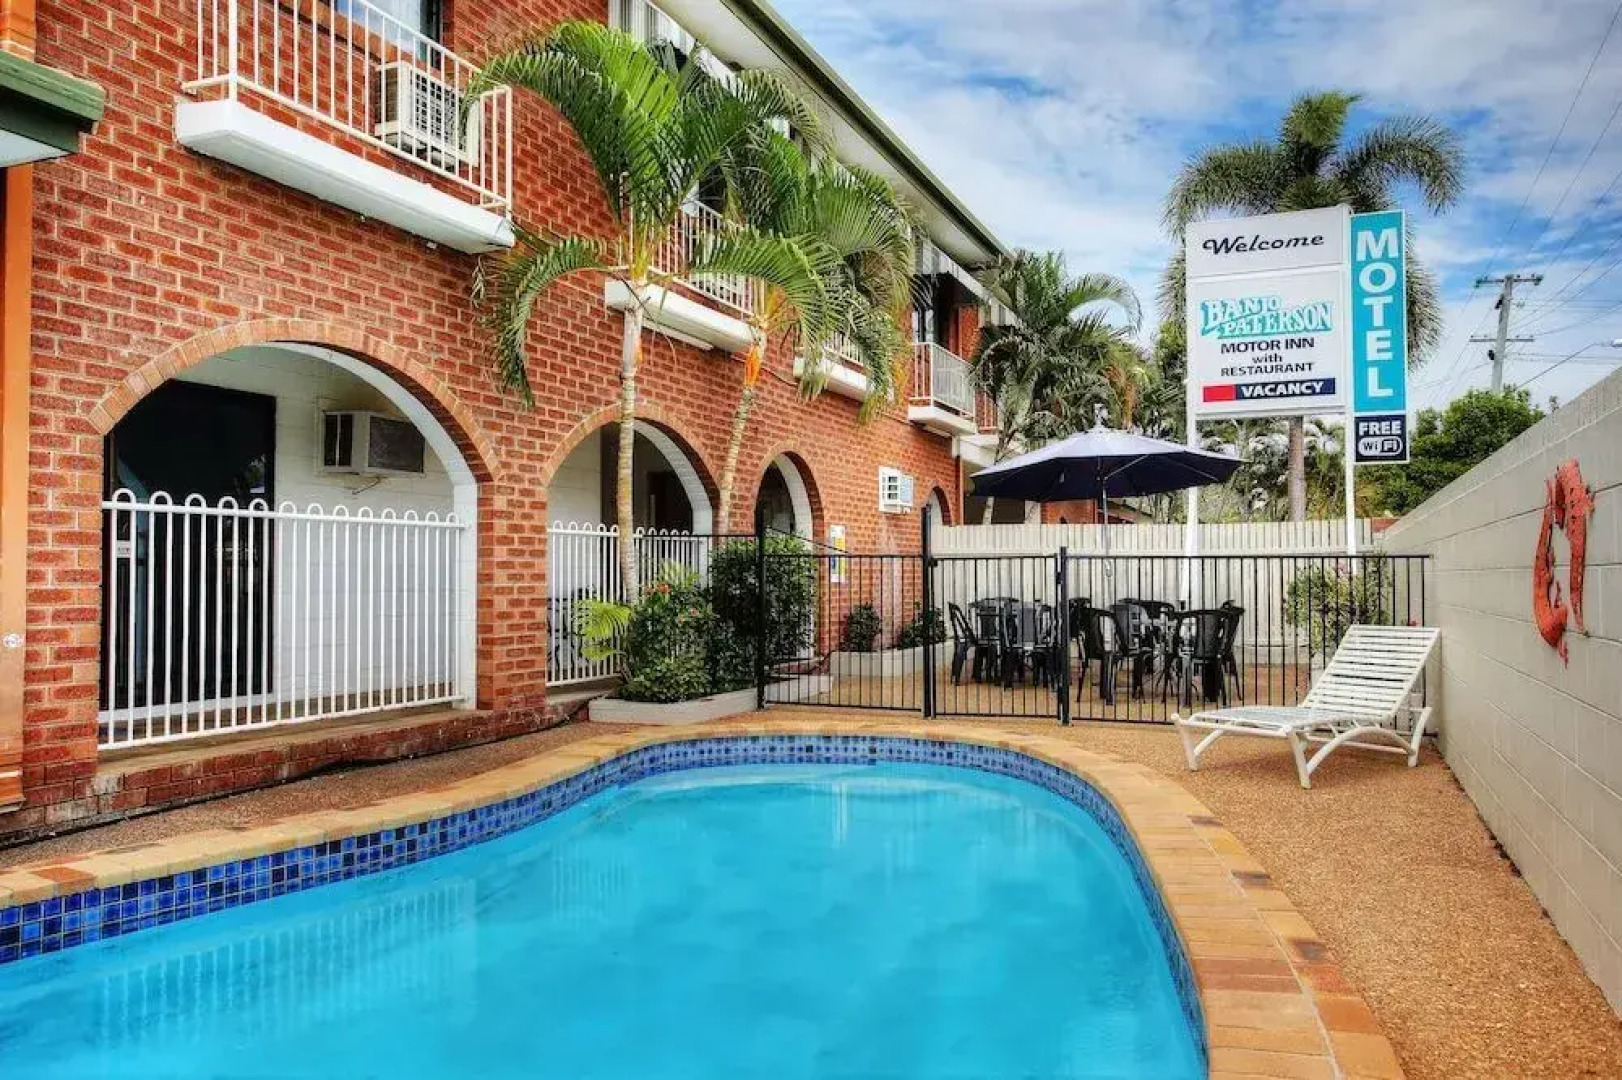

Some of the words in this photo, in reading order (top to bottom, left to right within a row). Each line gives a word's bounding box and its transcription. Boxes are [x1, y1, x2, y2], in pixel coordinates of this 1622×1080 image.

[1203, 234, 1324, 255] Welcome
[1218, 302, 1332, 338] PATERSON
[1356, 228, 1398, 398] MOTEL
[1220, 339, 1281, 354] MOTOR
[1285, 337, 1314, 349] INN
[1252, 353, 1283, 364] with
[1220, 362, 1314, 377] RESTAURANT
[1241, 381, 1324, 397] VACANCY
[1359, 421, 1401, 436] FREE
